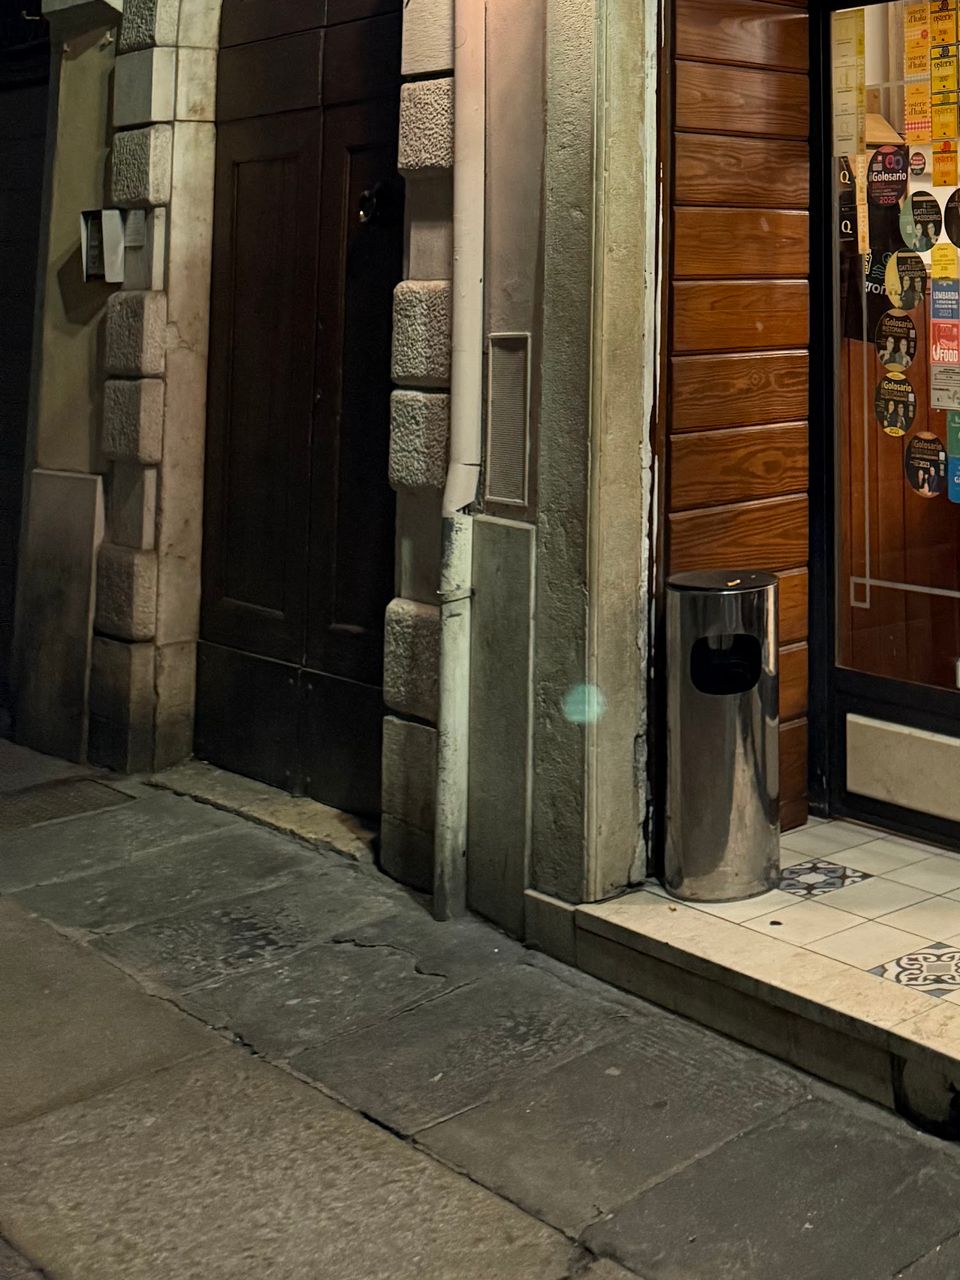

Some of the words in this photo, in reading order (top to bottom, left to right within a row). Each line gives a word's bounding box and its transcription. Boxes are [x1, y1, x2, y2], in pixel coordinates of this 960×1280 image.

[872, 170, 907, 182] Golosario
[940, 350, 958, 362] FOOD
[884, 381, 913, 393] Golosario
